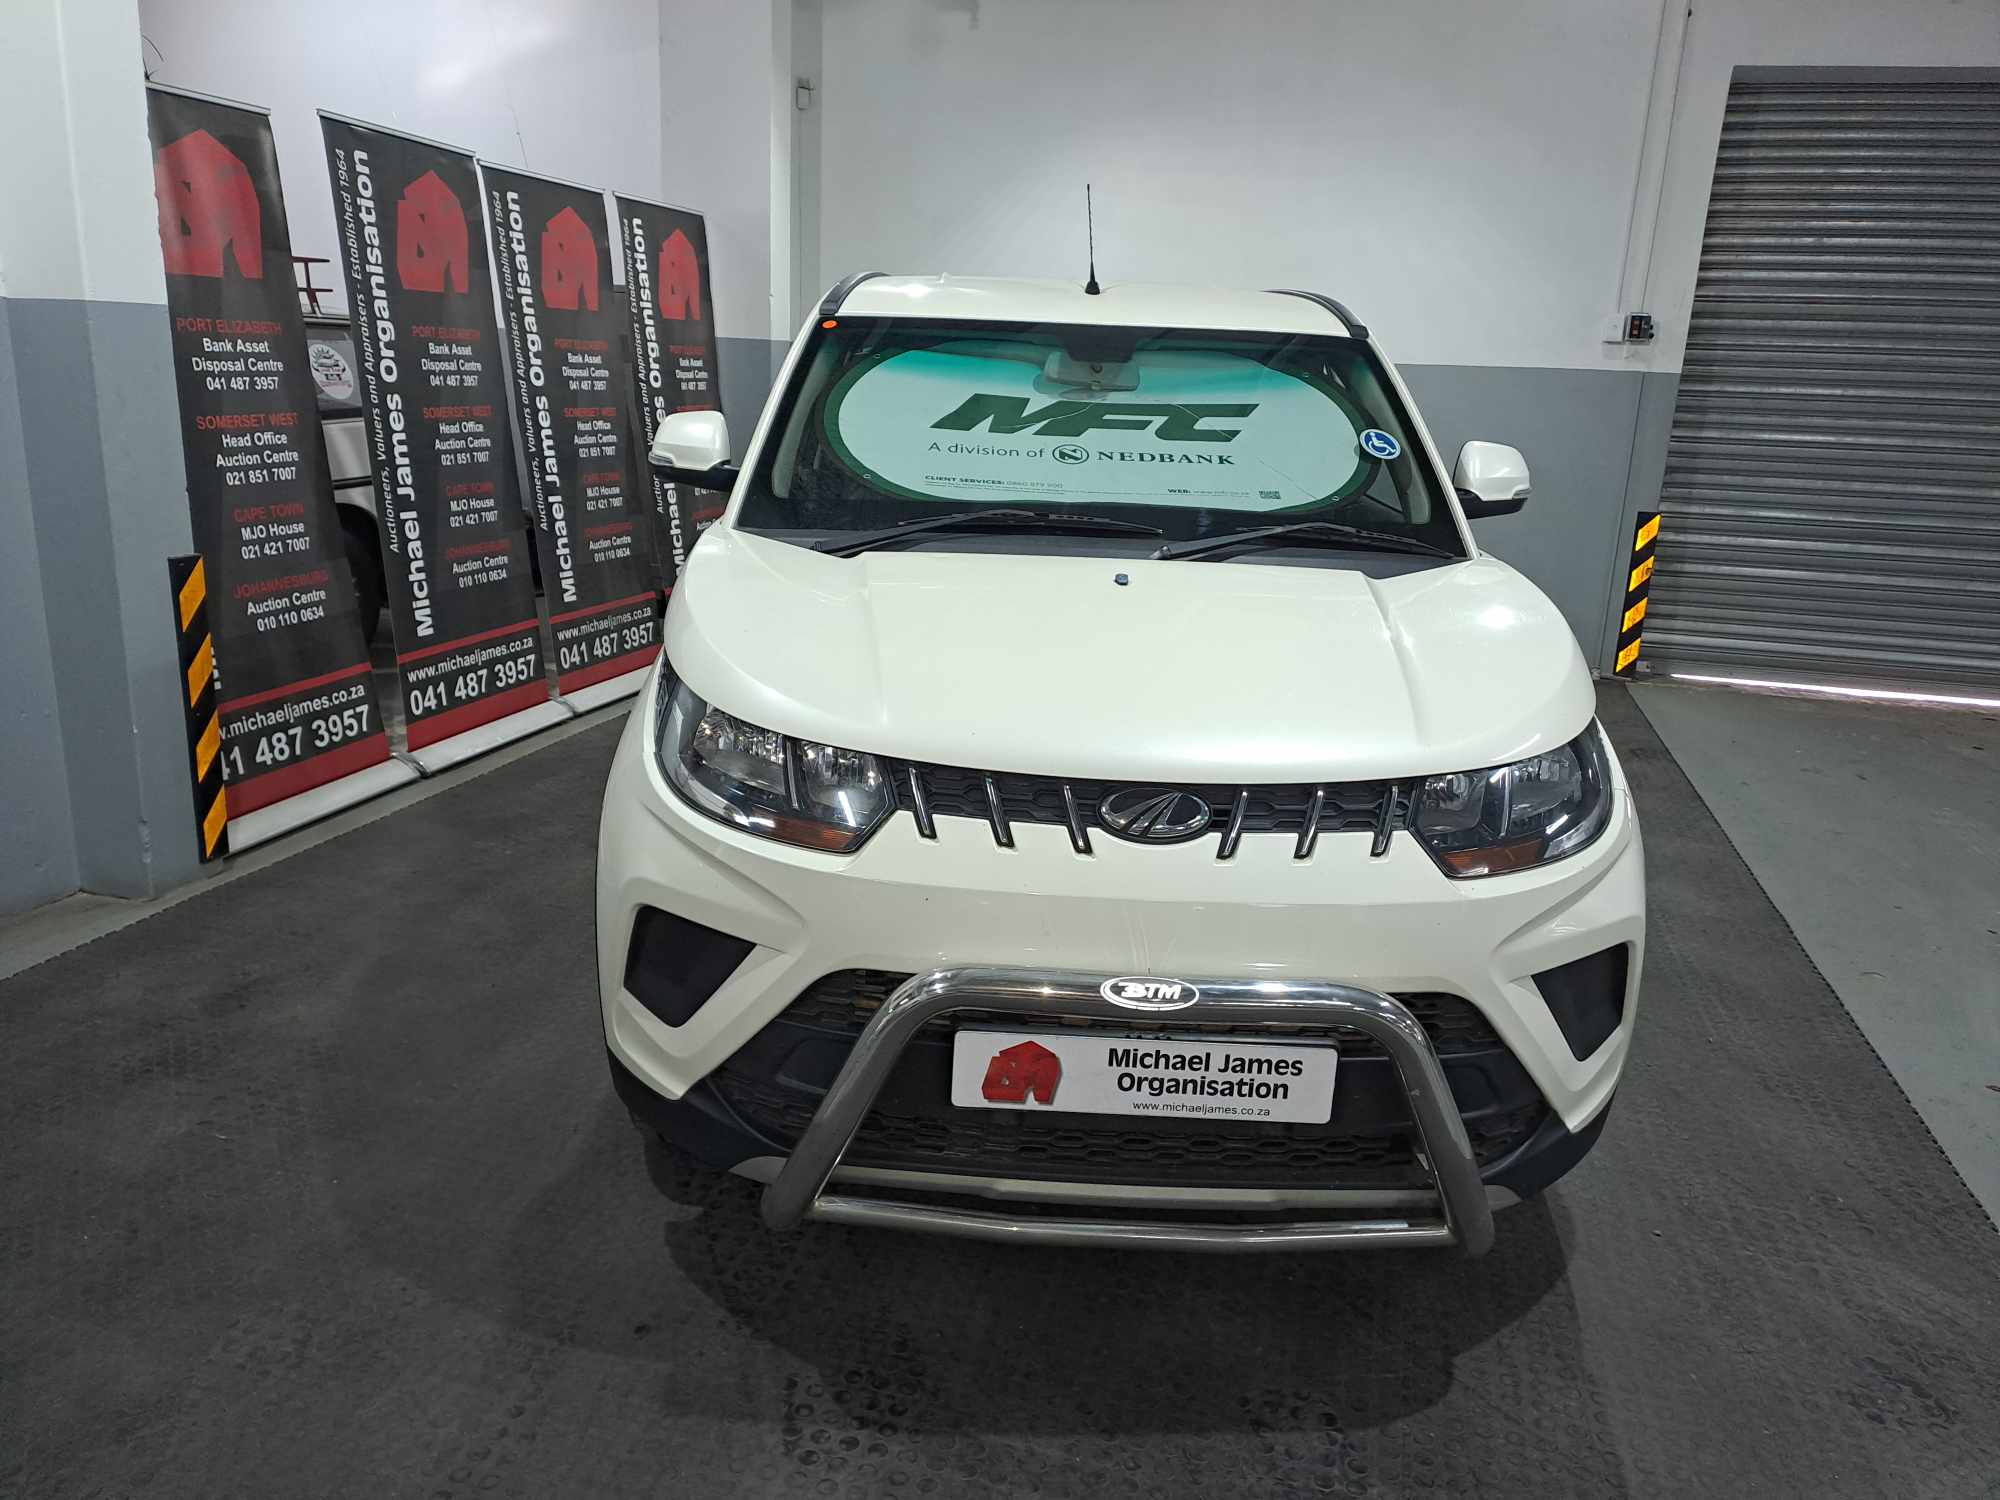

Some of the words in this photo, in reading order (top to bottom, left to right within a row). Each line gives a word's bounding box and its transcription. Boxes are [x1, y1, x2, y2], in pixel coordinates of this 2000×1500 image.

[336, 149, 349, 188] 1964
[492, 190, 503, 225] 1964
[340, 190, 362, 279] Established
[354, 150, 398, 383] Organisation
[496, 226, 514, 300] Established
[507, 191, 544, 387] Organisation
[632, 218, 662, 389] Organisation
[176, 317, 212, 333] PORT
[357, 294, 374, 372] Appraisers
[203, 338, 234, 352] Bank
[236, 339, 269, 352] Asset
[428, 342, 450, 354] Bank
[510, 312, 526, 377] Appraisers
[634, 323, 647, 381] Appraisers
[192, 357, 245, 374] Disposal
[248, 358, 284, 372] Centre
[422, 358, 458, 372] Disposal
[206, 377, 226, 390] 041
[230, 377, 250, 390] 487
[255, 377, 278, 390] 3957
[365, 374, 379, 403] and
[430, 374, 444, 386] 041
[518, 381, 529, 404] and
[196, 414, 266, 430] SOMERSET
[269, 412, 299, 426] WEST
[440, 422, 460, 434] Head
[462, 421, 484, 433] Office
[524, 408, 536, 452] Valuers
[929, 393, 1260, 442] MFC
[222, 434, 251, 448] Head
[254, 432, 288, 445] Office
[372, 408, 386, 460] Valuers
[386, 394, 415, 501] James
[435, 438, 466, 450] Auction
[536, 396, 560, 487] James
[216, 453, 261, 467] Auction
[264, 450, 299, 464] Centre
[441, 454, 454, 466] 021
[928, 442, 941, 452] A
[948, 443, 1019, 457] division
[1026, 448, 1046, 458] of
[1096, 451, 1235, 465] NEDBANK
[226, 471, 246, 486] 021
[250, 469, 270, 484] 851
[273, 467, 297, 482] 7007
[450, 500, 468, 512] MJO
[470, 498, 494, 510] House
[532, 457, 549, 531] Auctioneers,
[234, 507, 266, 522] CAPE
[382, 466, 399, 552] Auctioneers,
[450, 516, 463, 528] 021
[466, 514, 478, 525] 421
[241, 526, 266, 541] MJO
[269, 522, 304, 536] House
[241, 546, 260, 560] 021
[263, 543, 283, 556] 421
[286, 537, 310, 552] 7007
[548, 496, 577, 602] Michael
[400, 511, 434, 637] Michael
[452, 560, 482, 574] Auction
[484, 556, 508, 568] Centre
[459, 576, 472, 588] 010
[474, 572, 487, 584] 110
[247, 599, 290, 616] Auction
[292, 590, 326, 605] Centre
[256, 618, 276, 632] 010
[278, 611, 298, 627] 110
[300, 606, 325, 622] 0634
[557, 606, 651, 640] www.michaeljames.co.za
[408, 636, 534, 682] www.michaeljames.co.za
[560, 642, 588, 670] 041
[593, 633, 618, 659] 487
[622, 622, 654, 648] 3957
[410, 682, 447, 716] 041
[454, 668, 488, 701] 487
[496, 654, 536, 688] 3957
[256, 726, 303, 766] 487
[312, 704, 369, 748] 3957
[1108, 1048, 1210, 1074] Michael
[1218, 1053, 1304, 1077] James
[1116, 1074, 1290, 1102] Organisation
[1132, 1102, 1270, 1118] www.michaeljames.co.za
